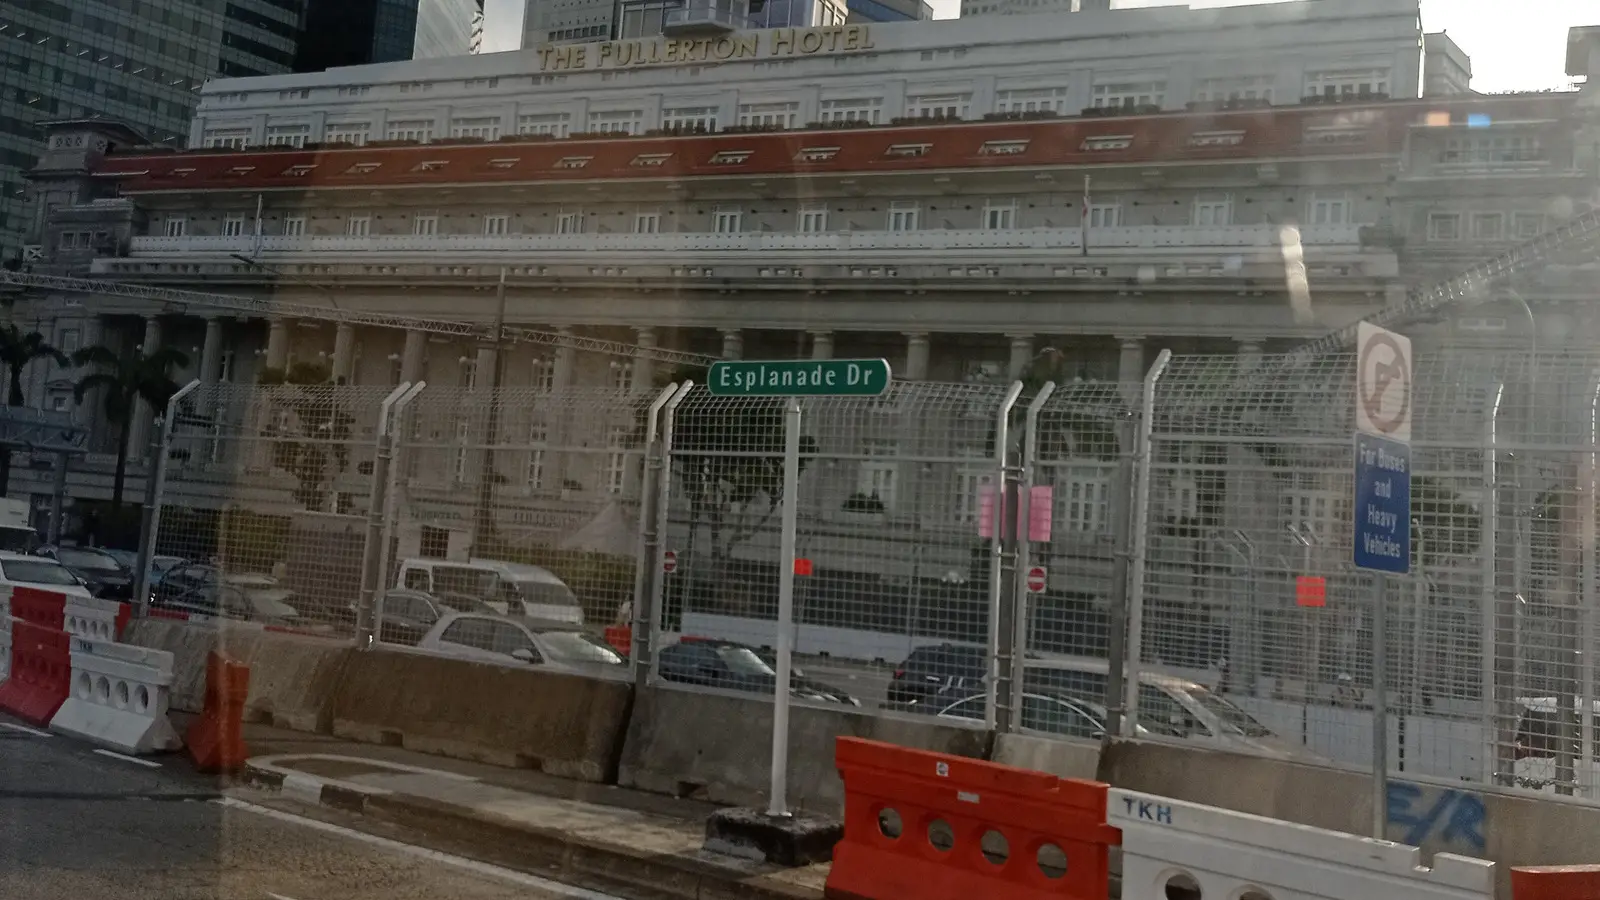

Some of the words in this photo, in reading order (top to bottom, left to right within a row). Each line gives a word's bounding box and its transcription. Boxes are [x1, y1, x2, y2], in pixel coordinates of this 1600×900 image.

[537, 44, 587, 71] THE
[597, 32, 759, 68] FULLERTON
[771, 25, 875, 57] HOTEL
[720, 364, 836, 391] Esplanade
[847, 363, 873, 386] Dr
[1360, 443, 1376, 465] For
[1378, 447, 1405, 473] Buses
[1374, 477, 1392, 499] and
[1367, 503, 1397, 534] Heavy
[1363, 531, 1401, 558] Vehicles
[1122, 797, 1172, 824] TKH
